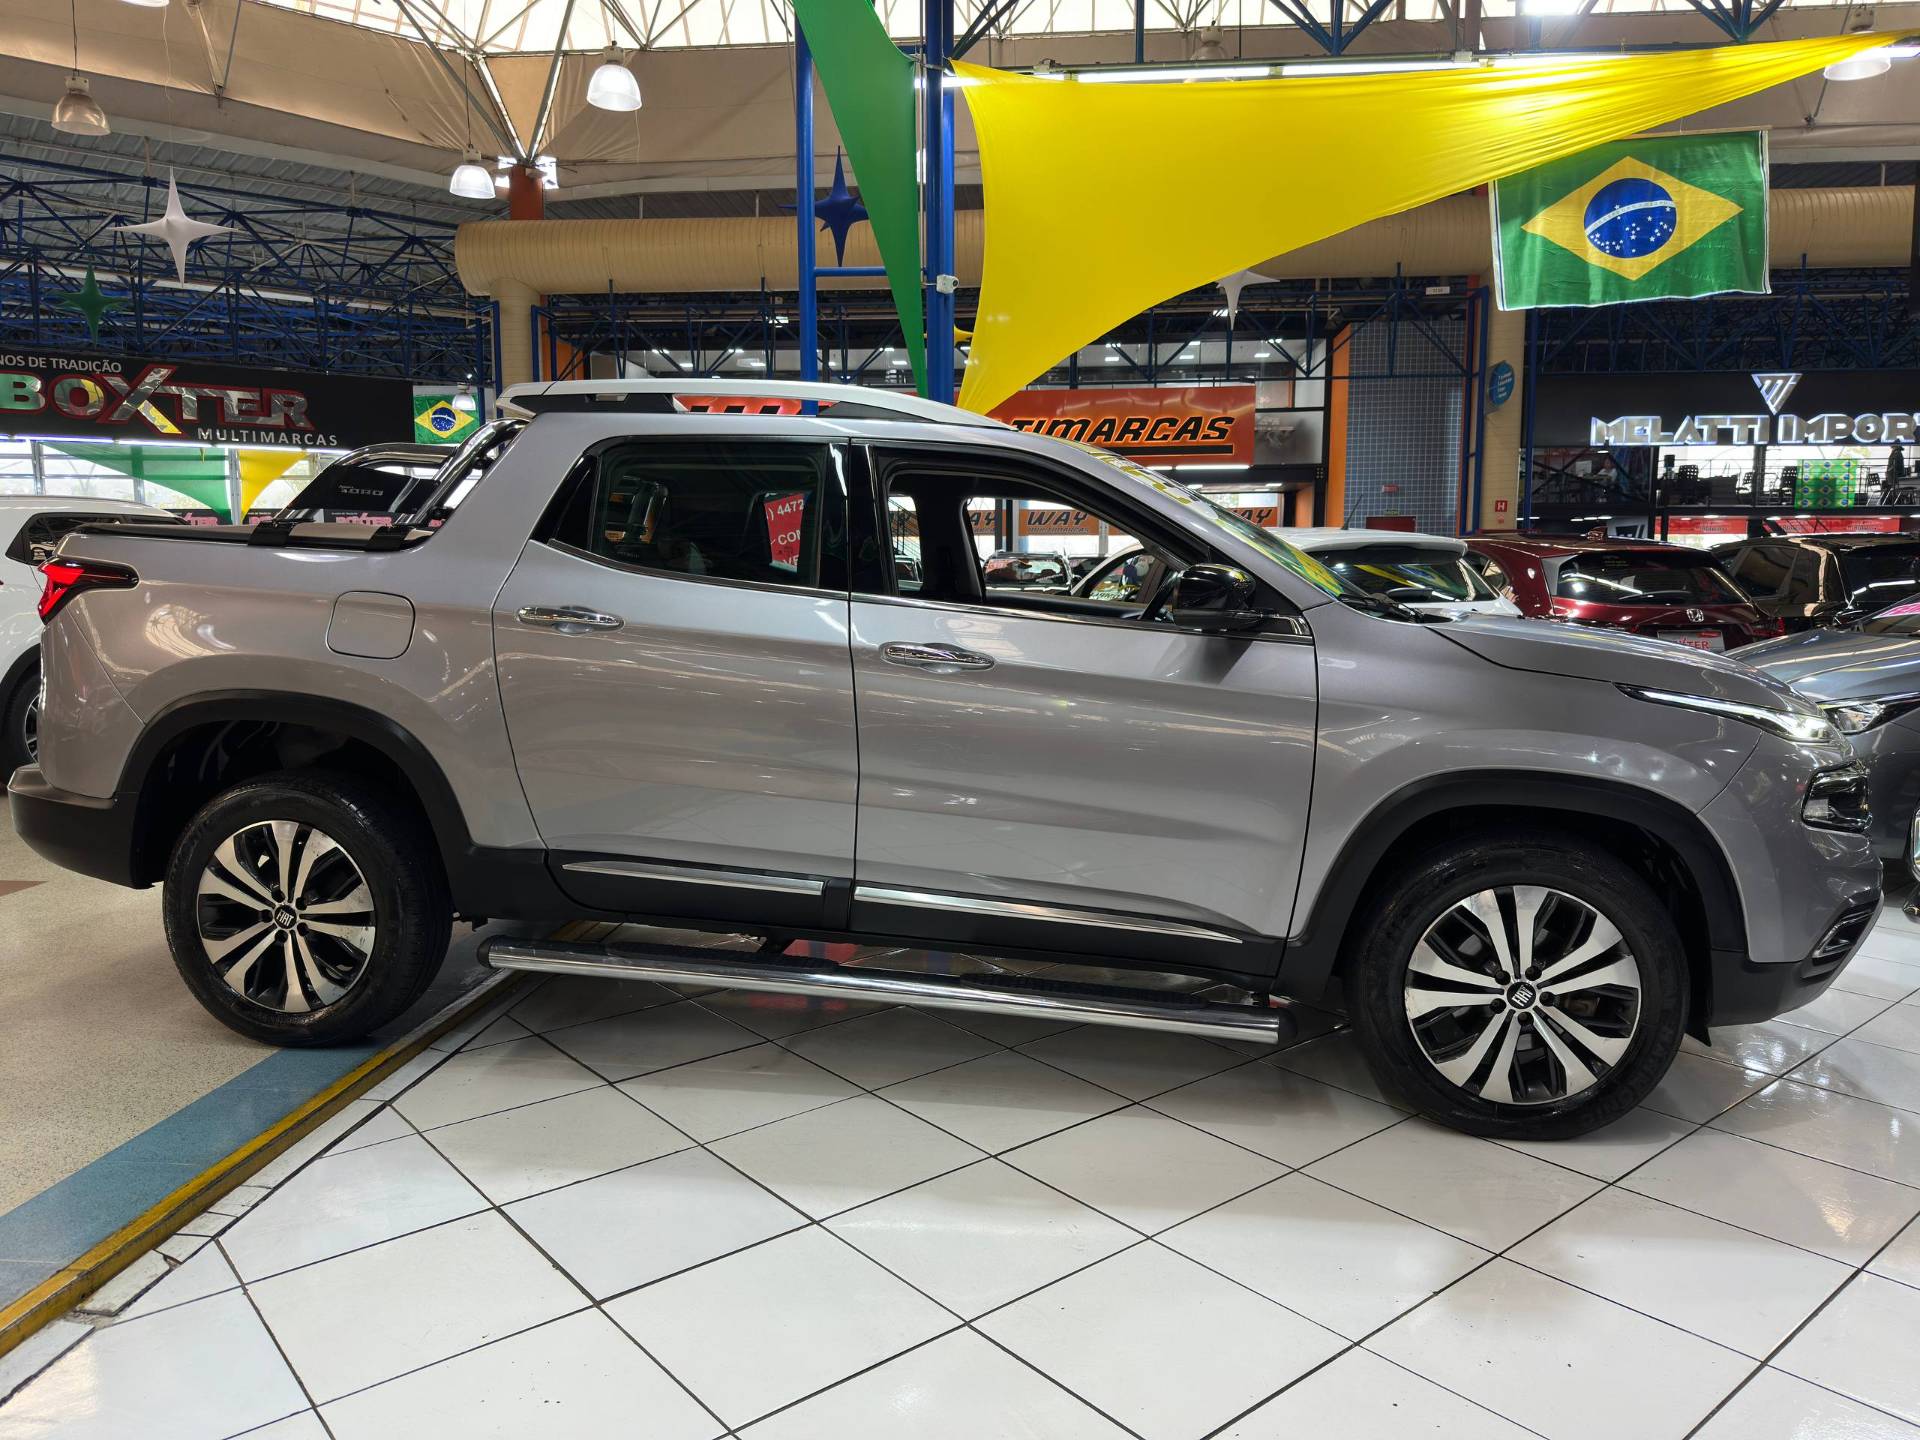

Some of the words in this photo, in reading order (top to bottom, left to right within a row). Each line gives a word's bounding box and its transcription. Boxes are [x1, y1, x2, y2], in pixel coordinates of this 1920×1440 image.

[28, 356, 47, 368] DE
[50, 357, 122, 374] TRADIÇÃO
[0, 364, 314, 436] BOXTER
[197, 426, 338, 446] MULTIMARCAS
[1590, 414, 1770, 446] MELATTI
[1777, 412, 1920, 444] IMPOR
[1027, 511, 1088, 526] WAY
[275, 908, 295, 928] FIAT
[1511, 983, 1534, 1007] FIAT
